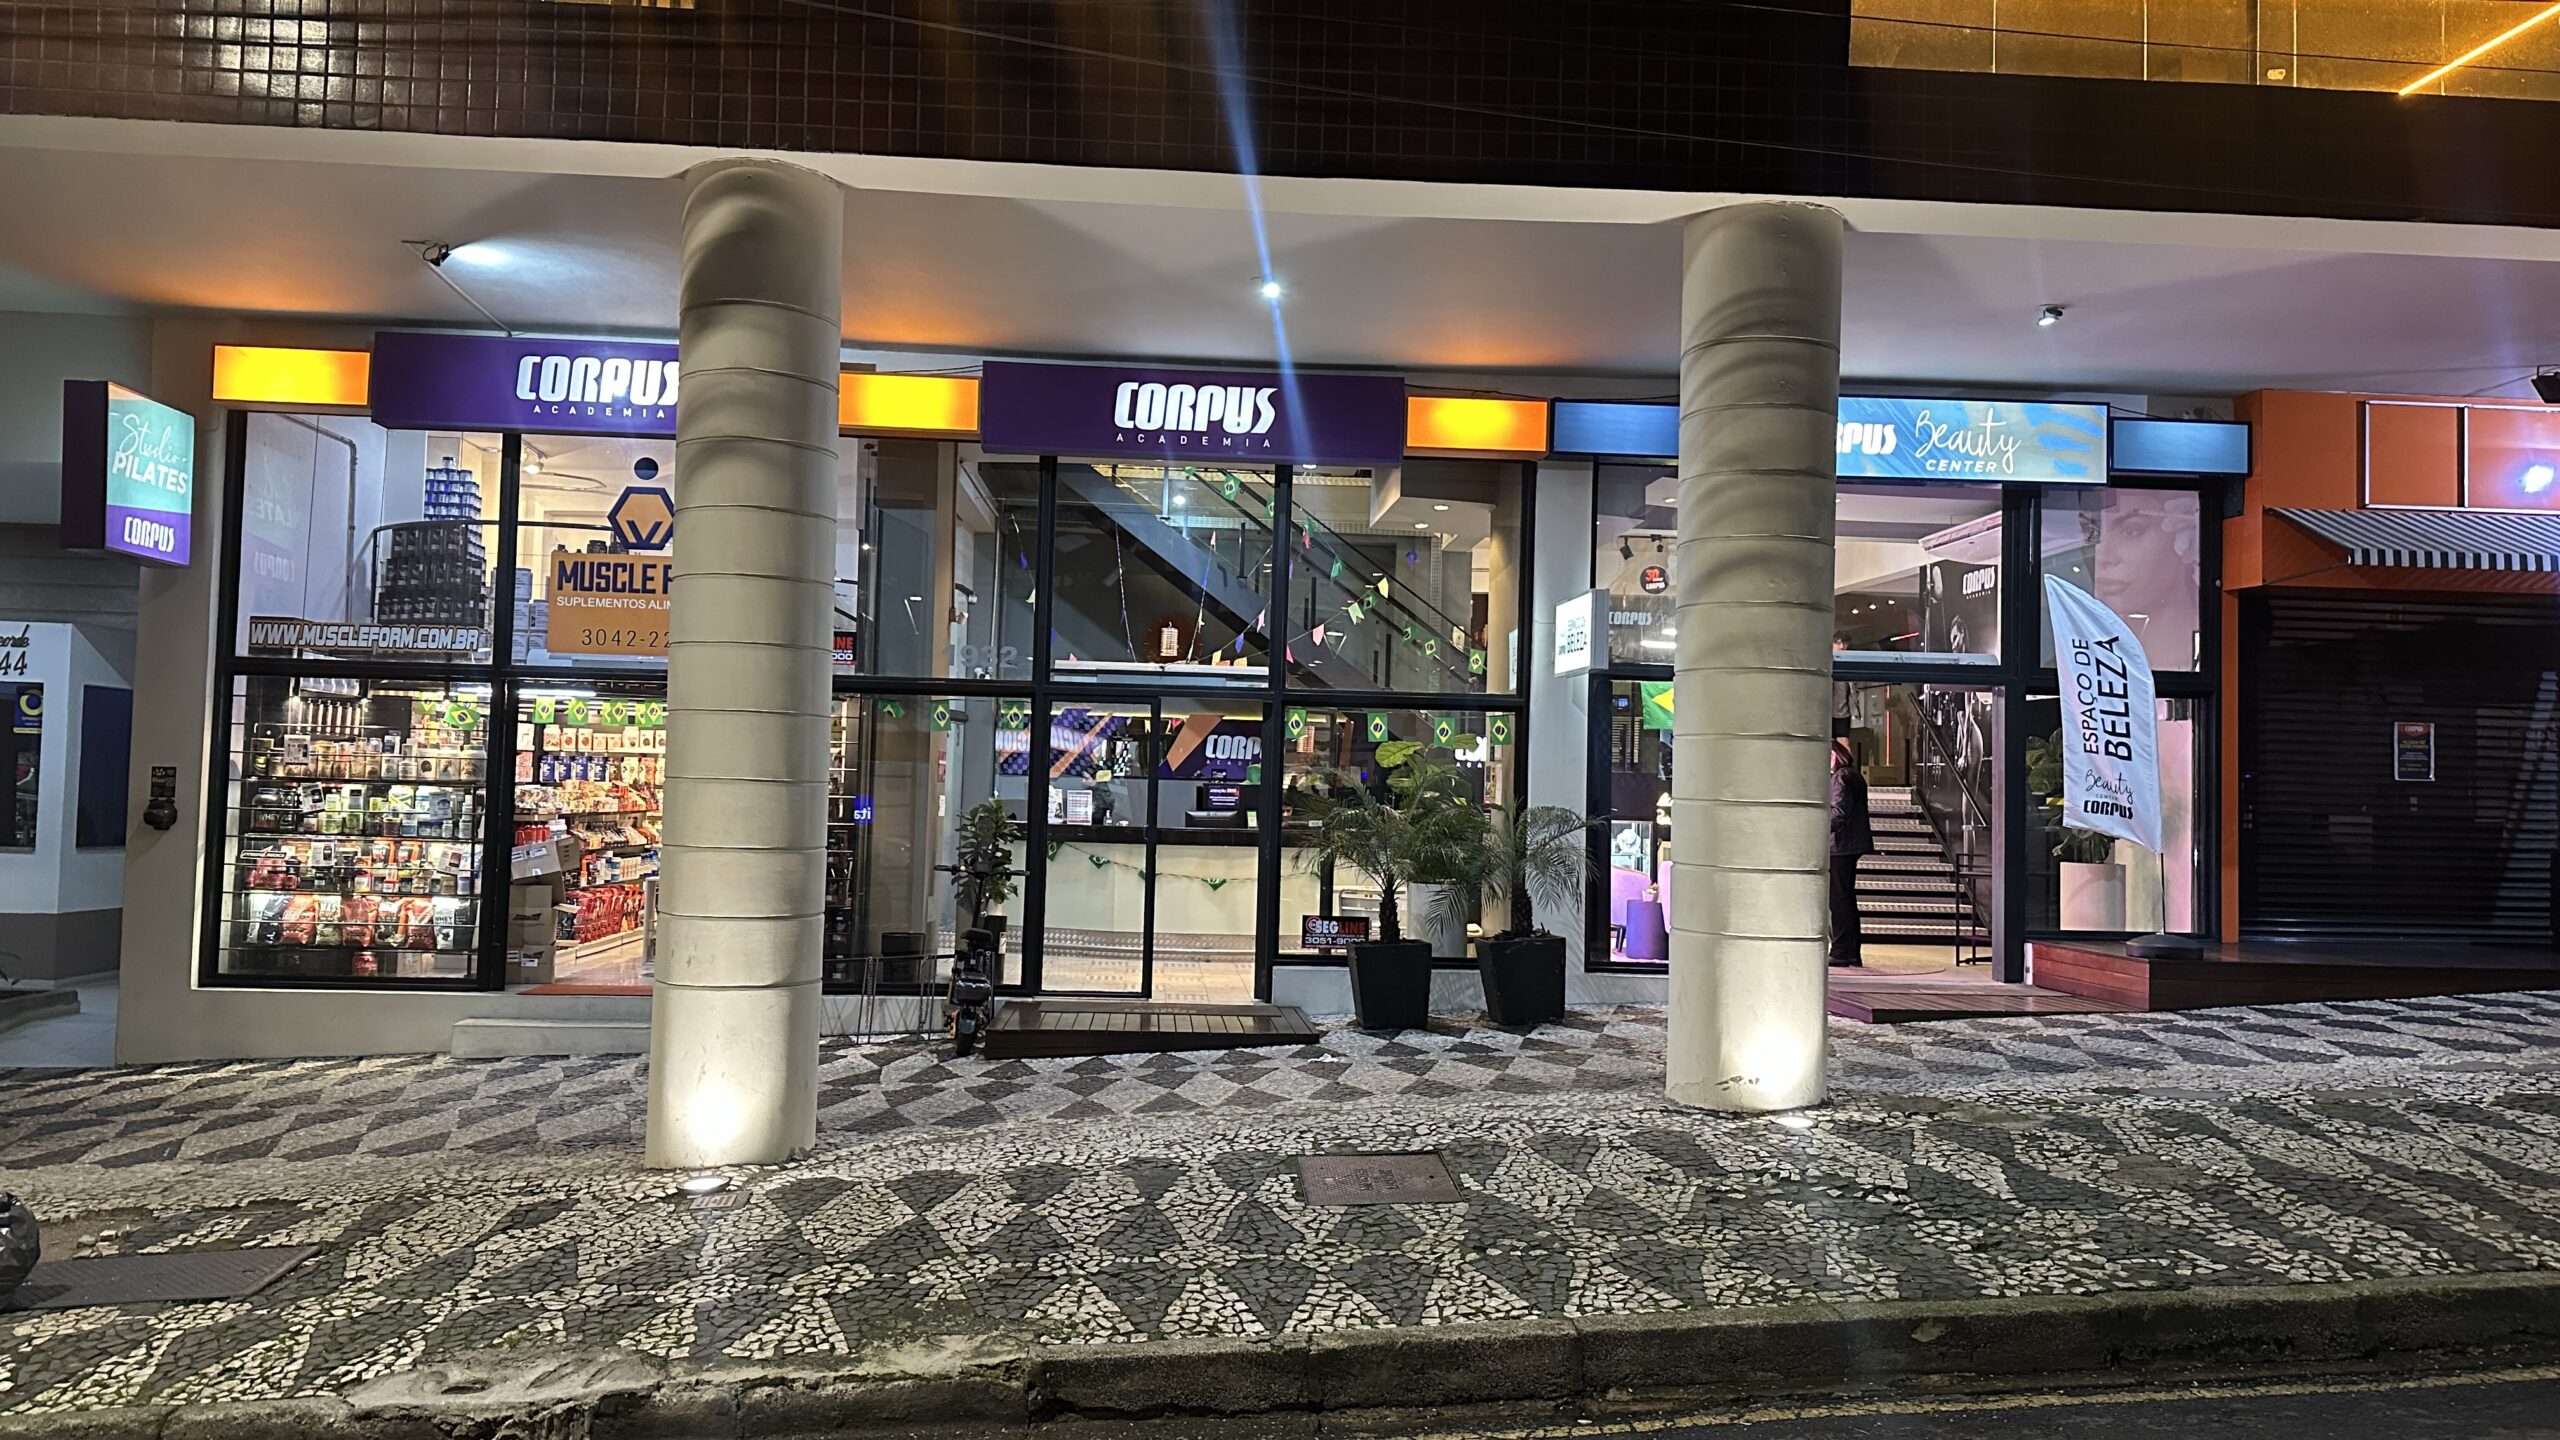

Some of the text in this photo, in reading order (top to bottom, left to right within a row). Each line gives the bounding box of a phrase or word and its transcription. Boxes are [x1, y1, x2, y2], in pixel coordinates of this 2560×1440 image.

[516, 355, 679, 406] CORPUS
[533, 404, 665, 419] ACADEMIA
[1114, 382, 1278, 434] CORPUS
[119, 413, 181, 464] Studio
[1116, 433, 1271, 448] ACADEMIA
[1915, 407, 2022, 474] Beauty
[112, 450, 189, 495] PILATES
[1926, 459, 1998, 473] CENTER
[124, 516, 175, 553] CORPUS
[557, 560, 657, 595] MUSCLE
[1962, 566, 1996, 595] CORPUS
[556, 596, 646, 609] SUPLEMENTOS
[1608, 611, 1653, 626] CORPUS
[251, 622, 480, 650] WWW.MUSCLEFORM.COM.BR
[2072, 638, 2100, 755] ESPAÇO DE
[2093, 635, 2133, 762] BELEZA
[1205, 735, 1262, 760] CORP
[2085, 769, 2134, 805] Beauty
[2083, 800, 2134, 820] CORPUS
